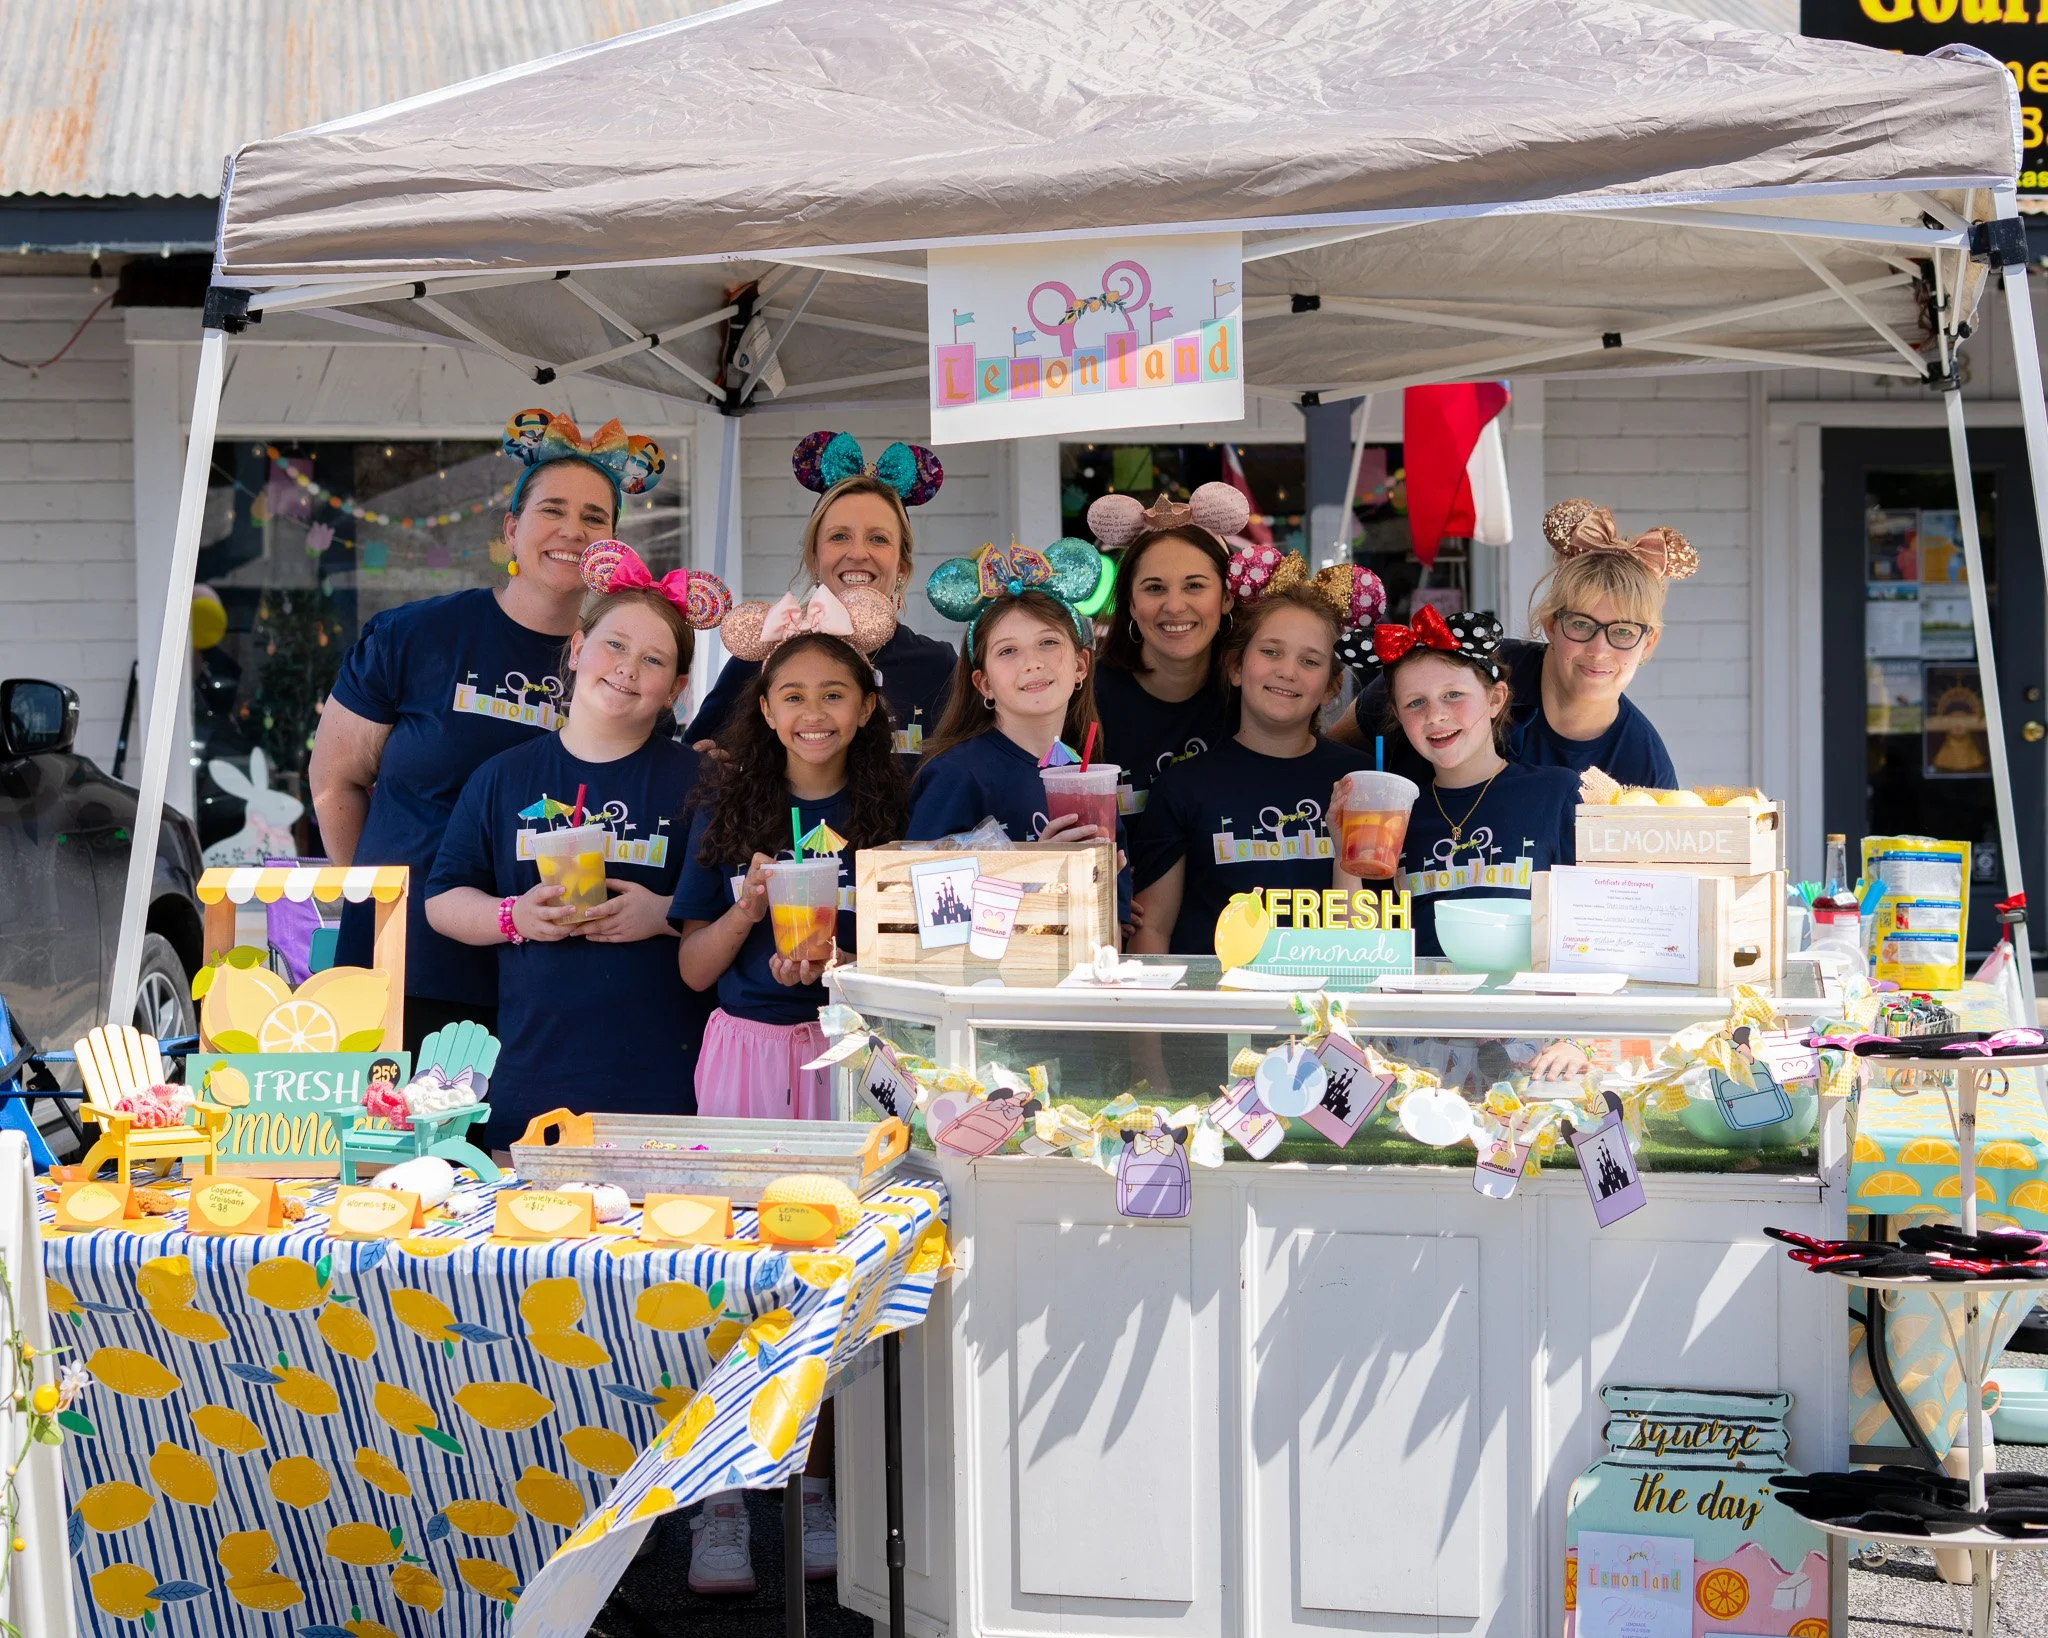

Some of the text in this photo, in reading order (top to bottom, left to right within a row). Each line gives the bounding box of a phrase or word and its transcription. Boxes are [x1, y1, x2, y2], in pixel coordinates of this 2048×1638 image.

[944, 326, 1229, 399] Lemonland
[458, 690, 565, 727] Lemonla
[1218, 832, 1328, 860] Lemonla
[1588, 829, 1733, 854] LEMONADE
[1266, 889, 1411, 930] FRESH
[1268, 932, 1399, 963] Lemonade
[254, 1069, 360, 1103] FRESH
[209, 1193, 245, 1206] Croissant
[1630, 1472, 1689, 1514] the
[1589, 1567, 1679, 1591] Lemonland
